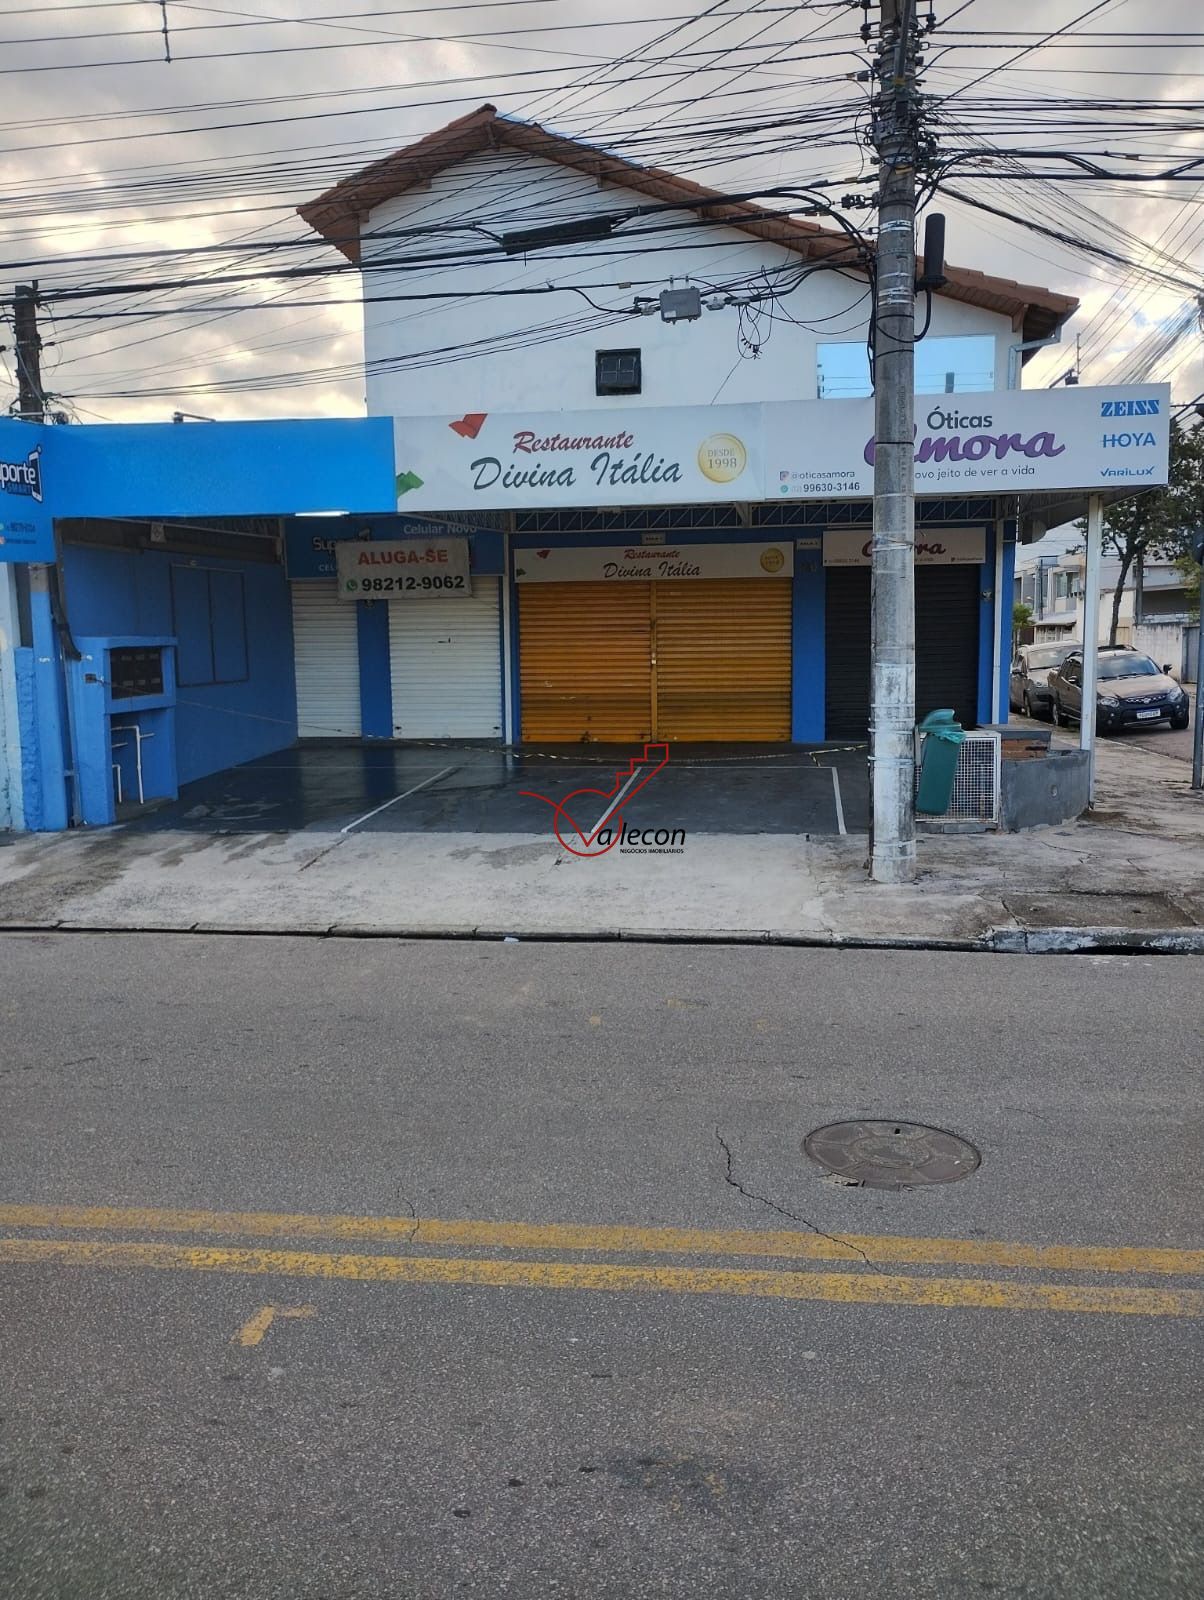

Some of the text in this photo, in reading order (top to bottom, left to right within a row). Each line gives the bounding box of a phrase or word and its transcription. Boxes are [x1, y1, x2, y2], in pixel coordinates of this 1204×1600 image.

[1101, 400, 1159, 417] ZEISS
[926, 406, 993, 430] Óticas
[512, 430, 634, 454] Restaurante
[863, 424, 1066, 467] mora
[1102, 432, 1156, 448] HOYA
[707, 448, 735, 458] DESDE
[470, 452, 683, 490] Divina Itália
[707, 457, 738, 469] 1998
[0, 461, 37, 489] porte
[914, 465, 1035, 481] ovo jeito de ver a vida
[803, 482, 861, 492] 99630-3146
[403, 523, 477, 534] Celular Novo
[358, 550, 449, 565] ALUGA-SE
[624, 549, 680, 559] Restaurante
[603, 561, 701, 578] Divina Itália
[362, 575, 465, 592] 98212-9062
